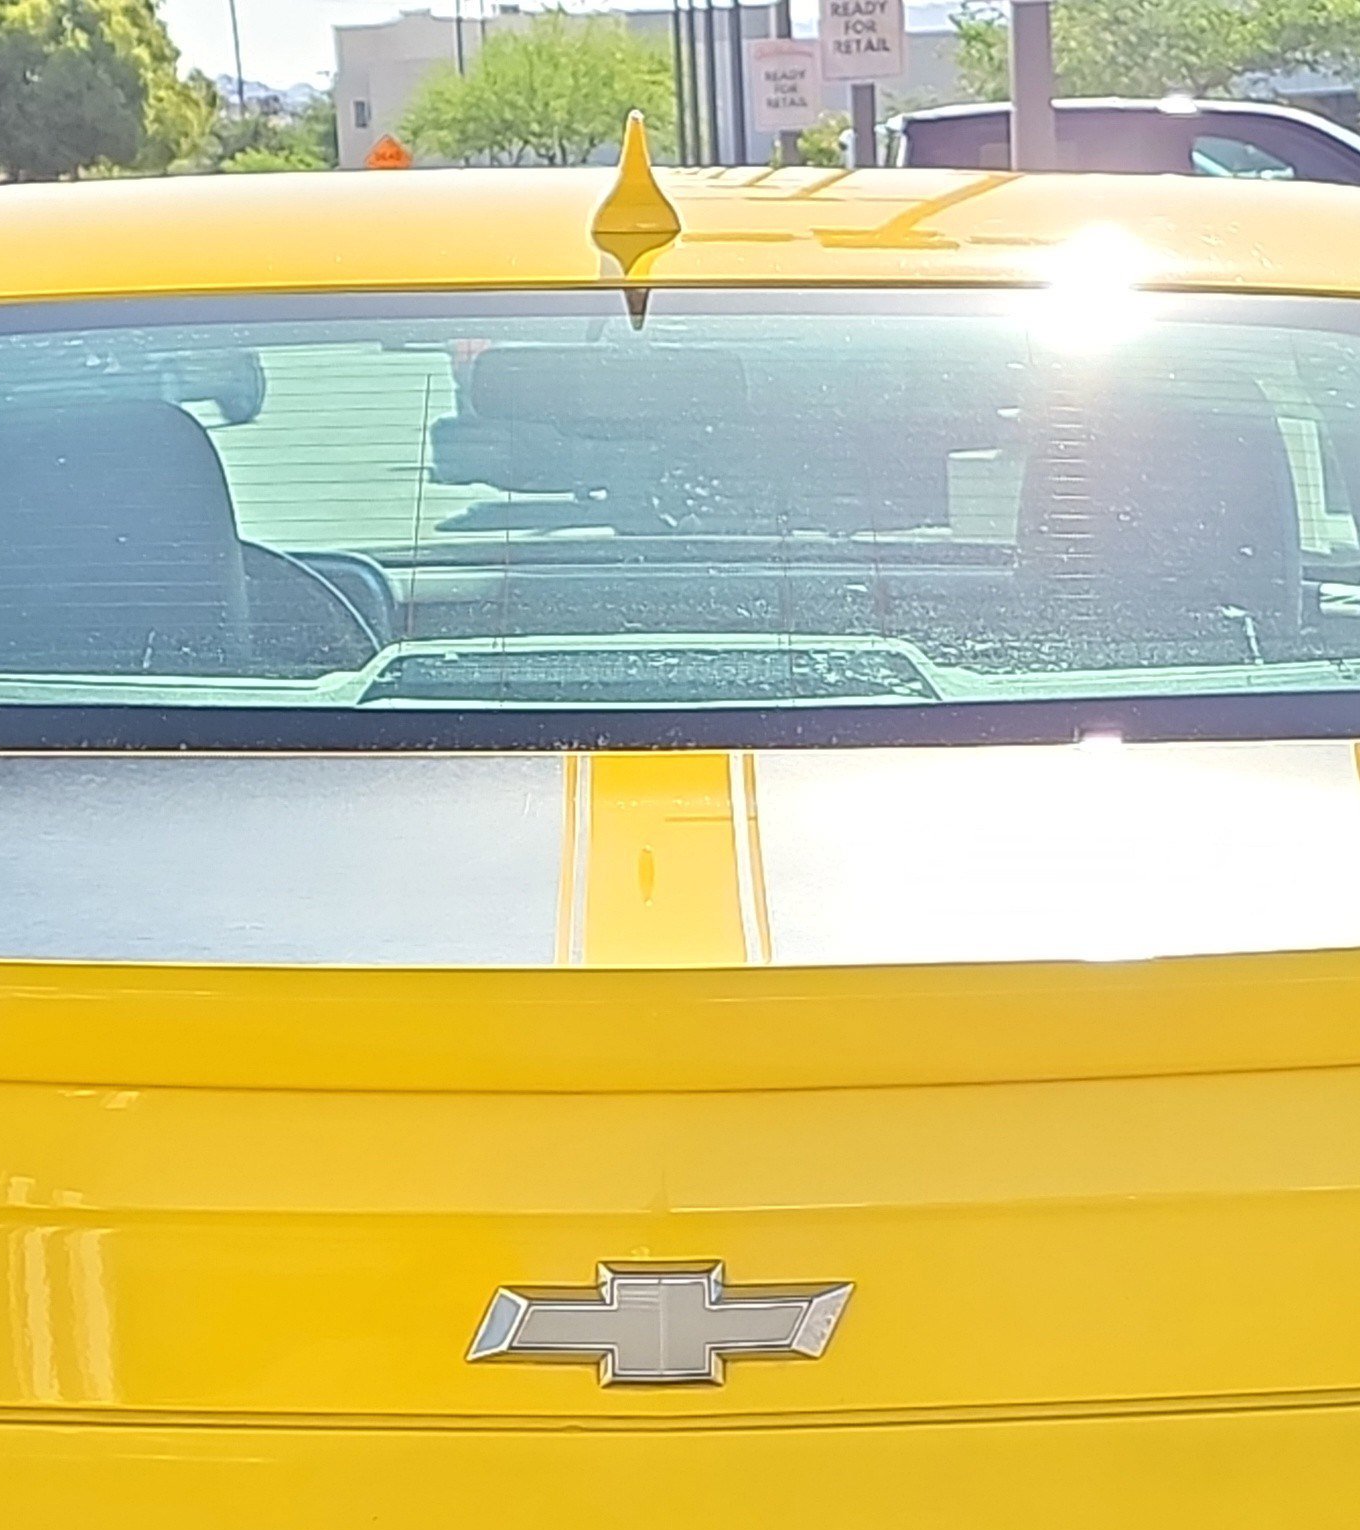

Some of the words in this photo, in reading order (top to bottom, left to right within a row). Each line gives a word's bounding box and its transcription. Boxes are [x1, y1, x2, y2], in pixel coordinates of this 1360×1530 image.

[830, 1, 887, 17] READY
[844, 20, 877, 35] FOR
[833, 38, 890, 54] RETAIL
